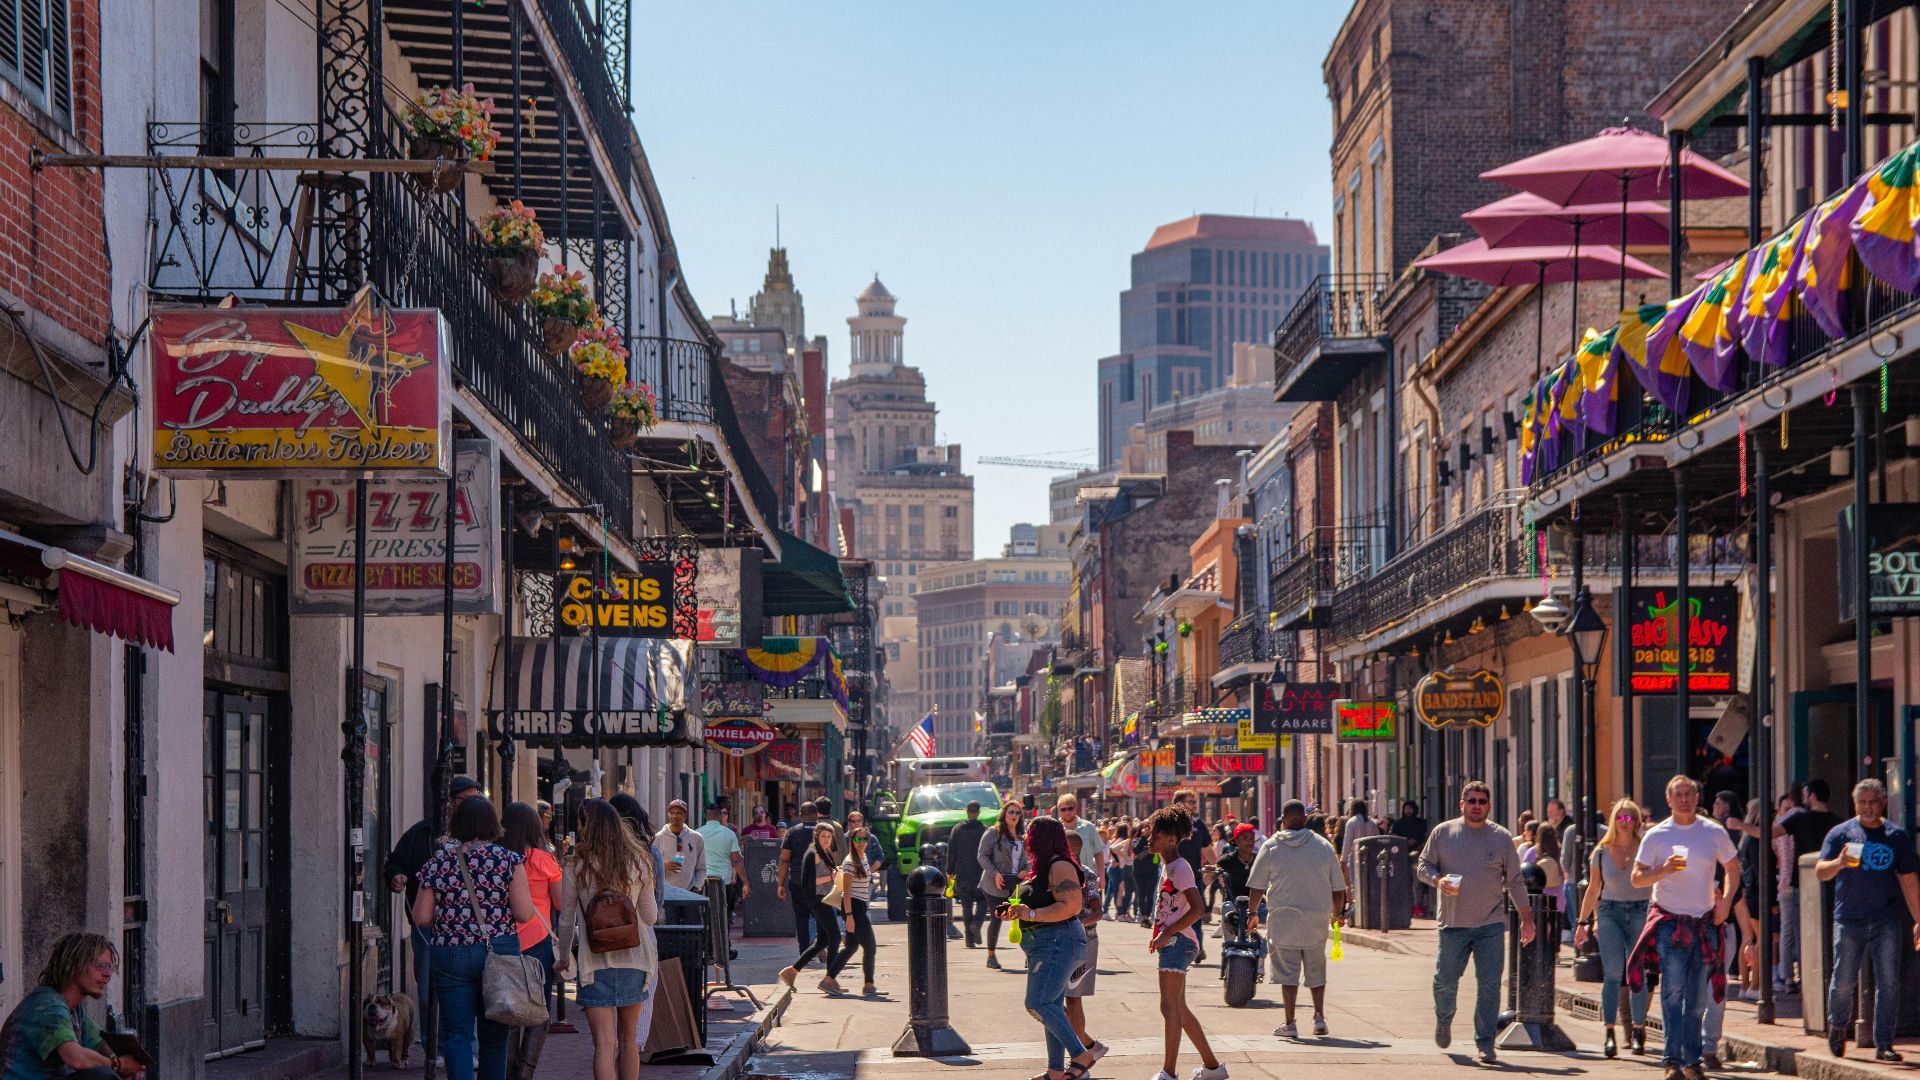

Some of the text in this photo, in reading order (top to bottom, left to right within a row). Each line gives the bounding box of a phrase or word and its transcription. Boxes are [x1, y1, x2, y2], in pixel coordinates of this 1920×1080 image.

[177, 318, 276, 381] Big
[162, 374, 350, 438] Daddy's
[164, 432, 433, 466] Bottomless Topless
[306, 487, 478, 531] PIZZA
[336, 538, 449, 558] EPRESS
[392, 564, 423, 586] THE
[1631, 615, 1728, 647] BIG ASY
[1424, 691, 1500, 709] BANDSTAND
[704, 728, 775, 741] DIXIELAND
[1271, 718, 1333, 729] CABARE
[1245, 755, 1265, 772] CLUB
